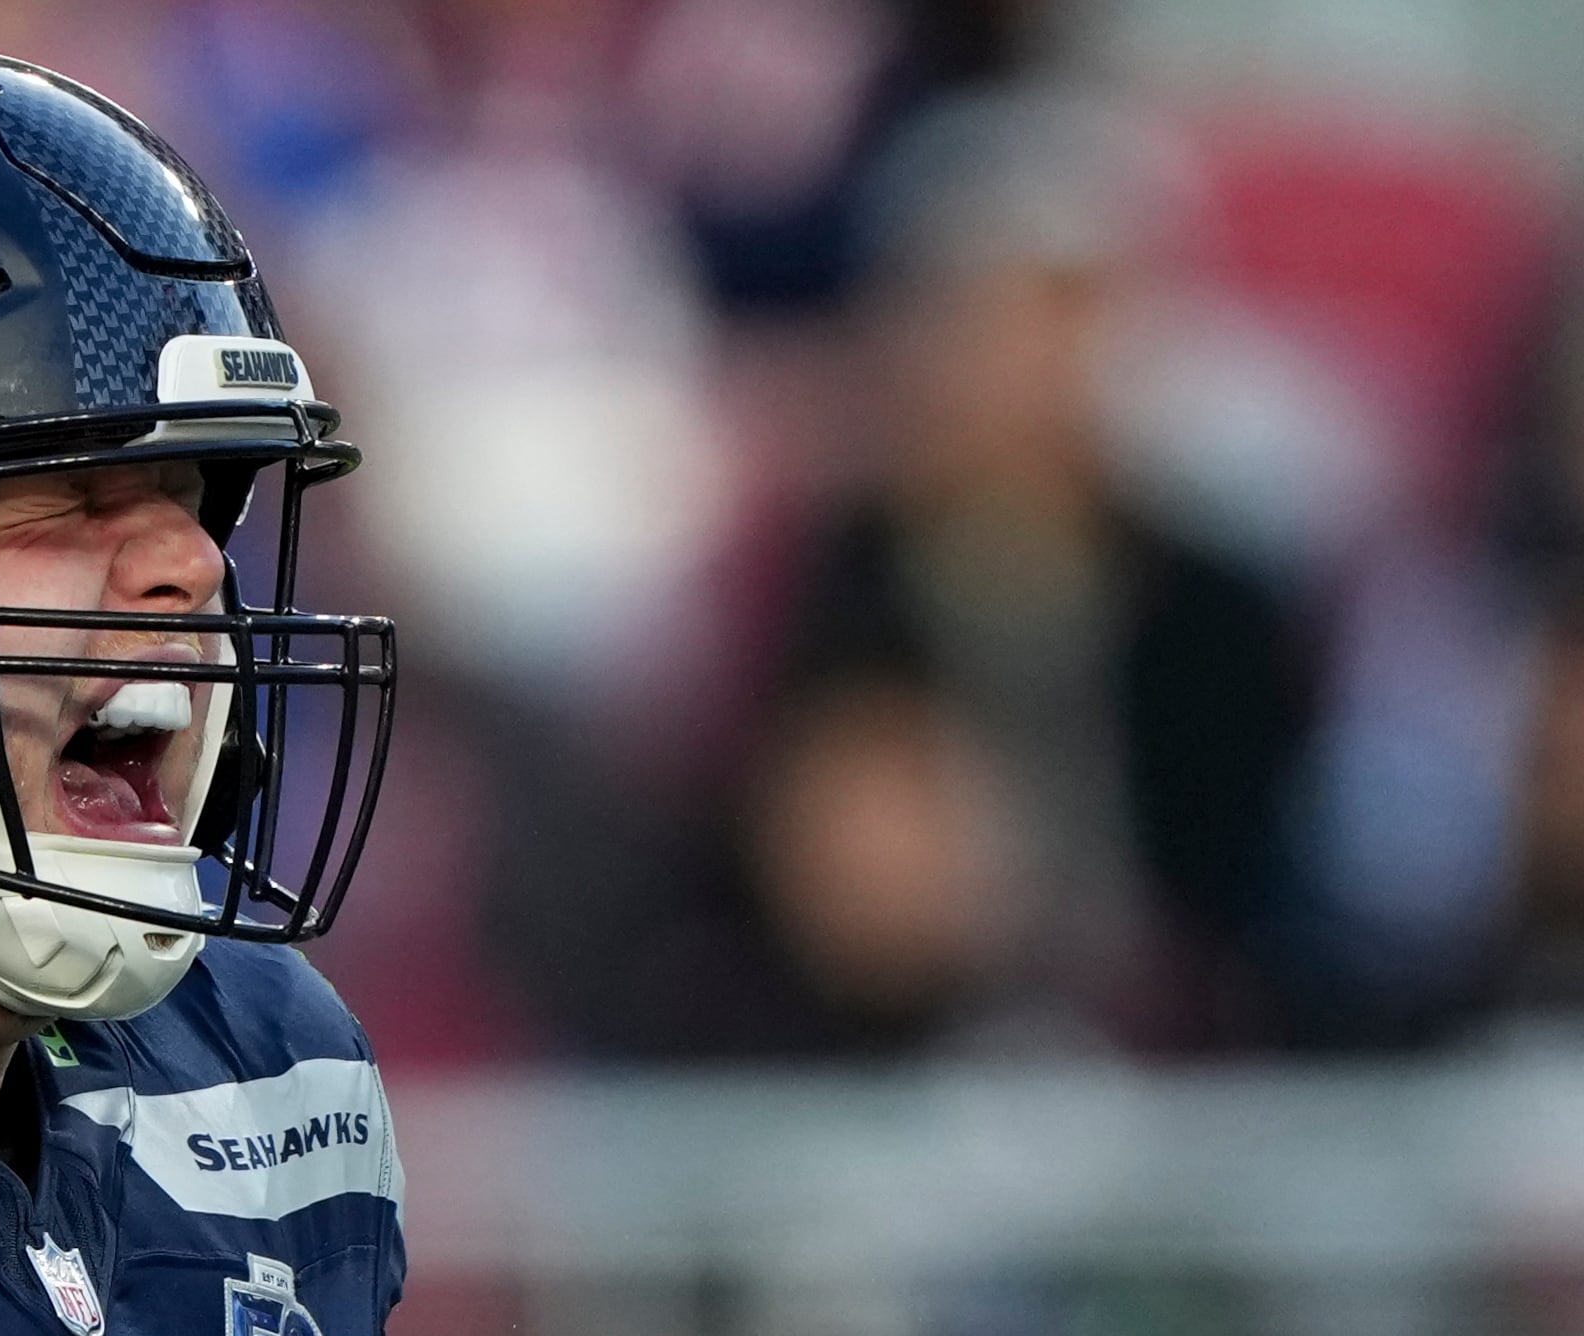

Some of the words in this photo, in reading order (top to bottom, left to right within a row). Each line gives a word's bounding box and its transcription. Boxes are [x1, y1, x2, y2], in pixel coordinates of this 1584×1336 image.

[220, 349, 299, 385] SEAHAWKS
[187, 1111, 369, 1172] SEAHAWKS
[56, 1285, 99, 1327] NFL
